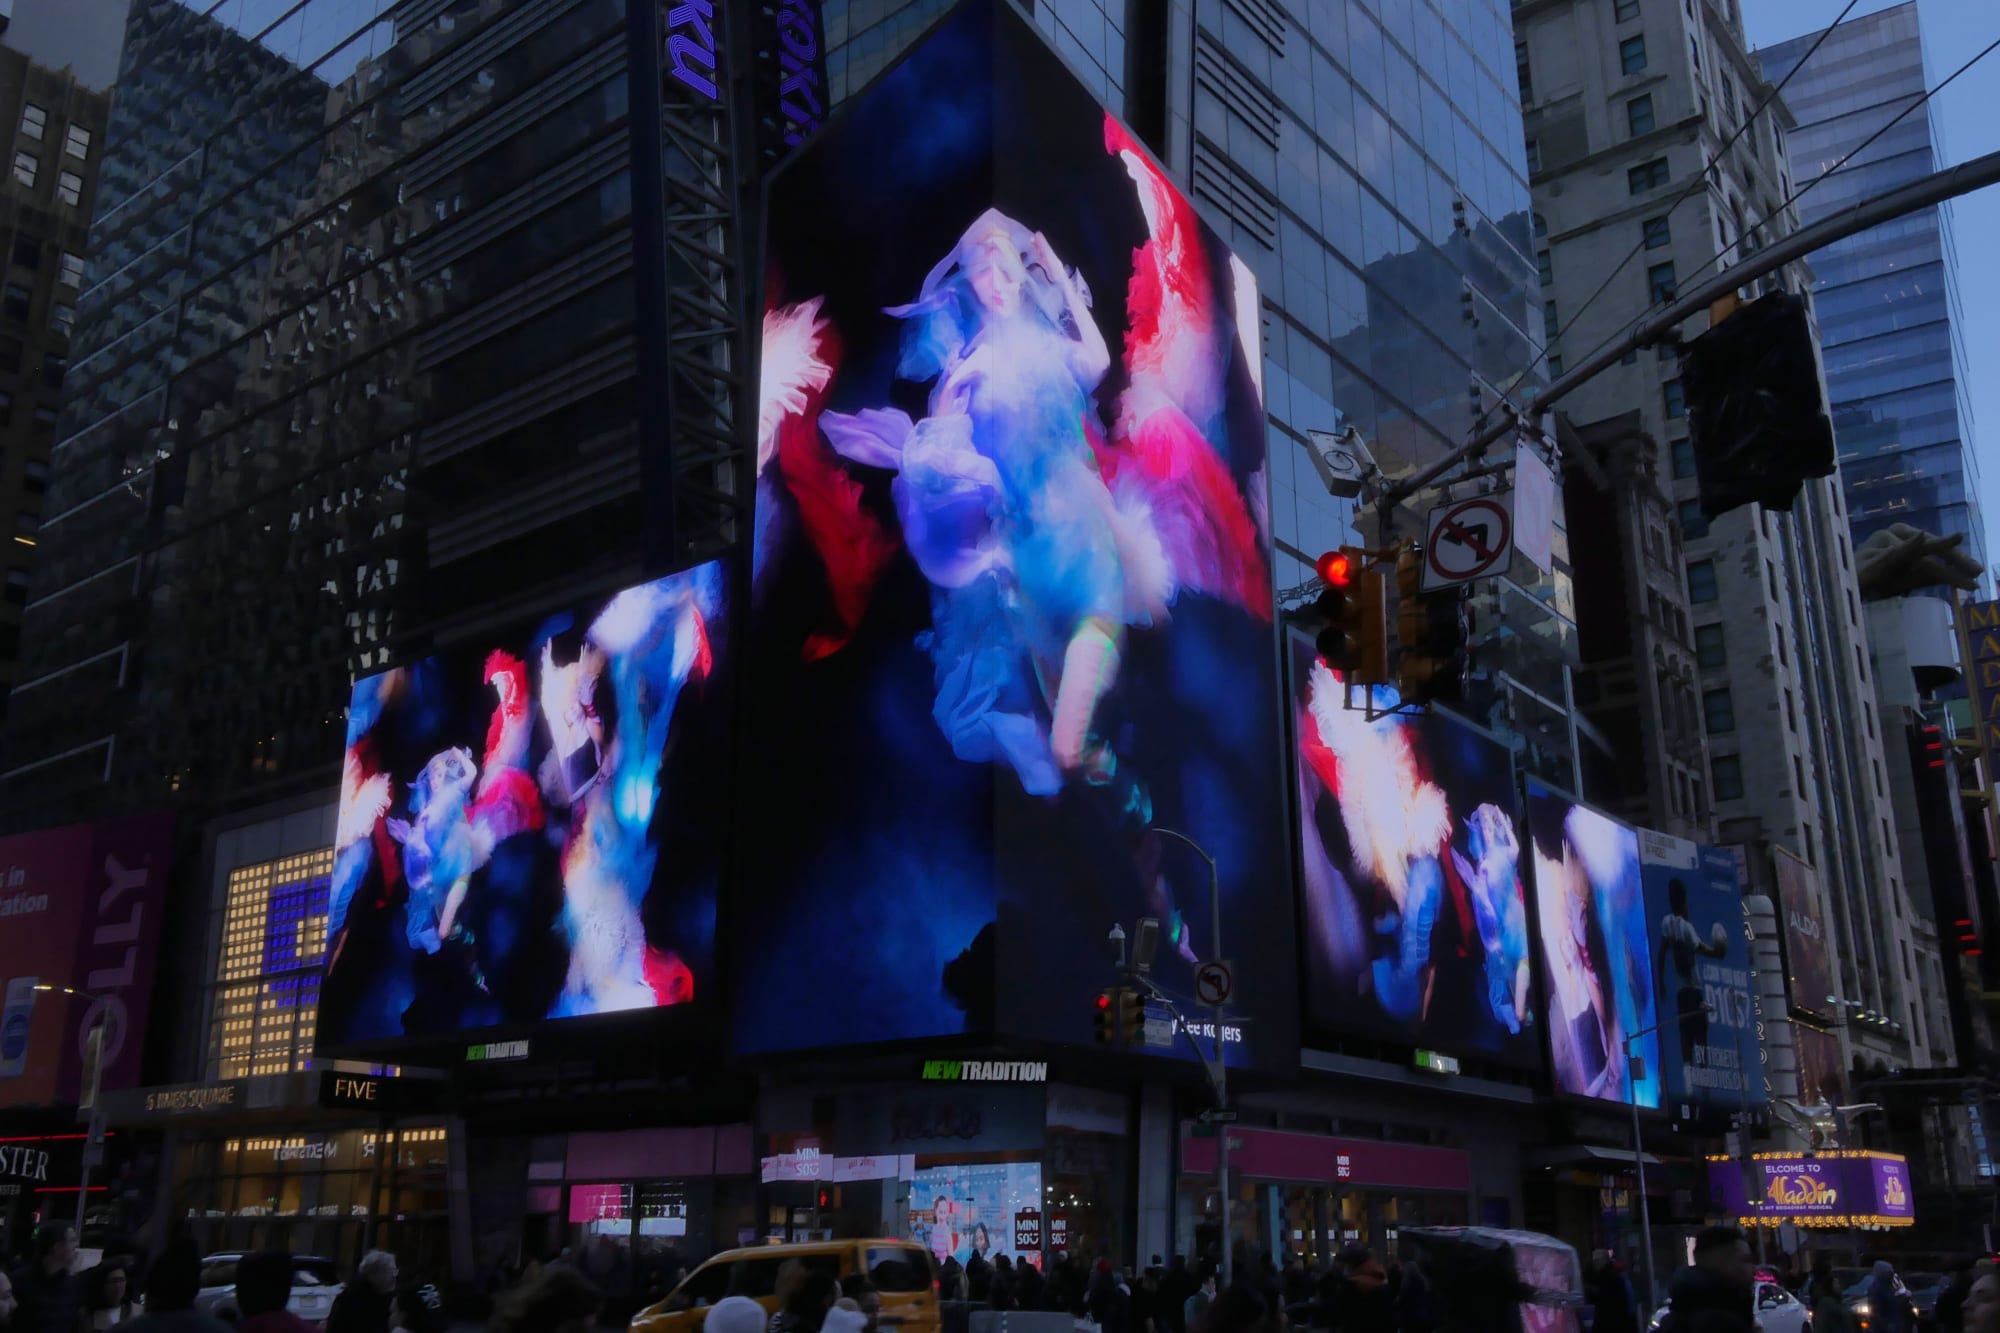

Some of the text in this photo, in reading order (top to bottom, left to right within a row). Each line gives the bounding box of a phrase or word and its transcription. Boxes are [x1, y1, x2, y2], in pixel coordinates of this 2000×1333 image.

[1790, 909, 1820, 940] ALDO
[77, 852, 152, 1069] OLLY
[922, 1060, 1047, 1082] NEWTRADITION
[335, 1079, 377, 1101] FIVE
[797, 1147, 820, 1160] MINI
[1765, 1164, 1821, 1174] ELCOME TO
[1767, 1175, 1837, 1205] Aladdin
[1017, 1219, 1039, 1231] MINI
[1051, 1219, 1066, 1231] MINI
